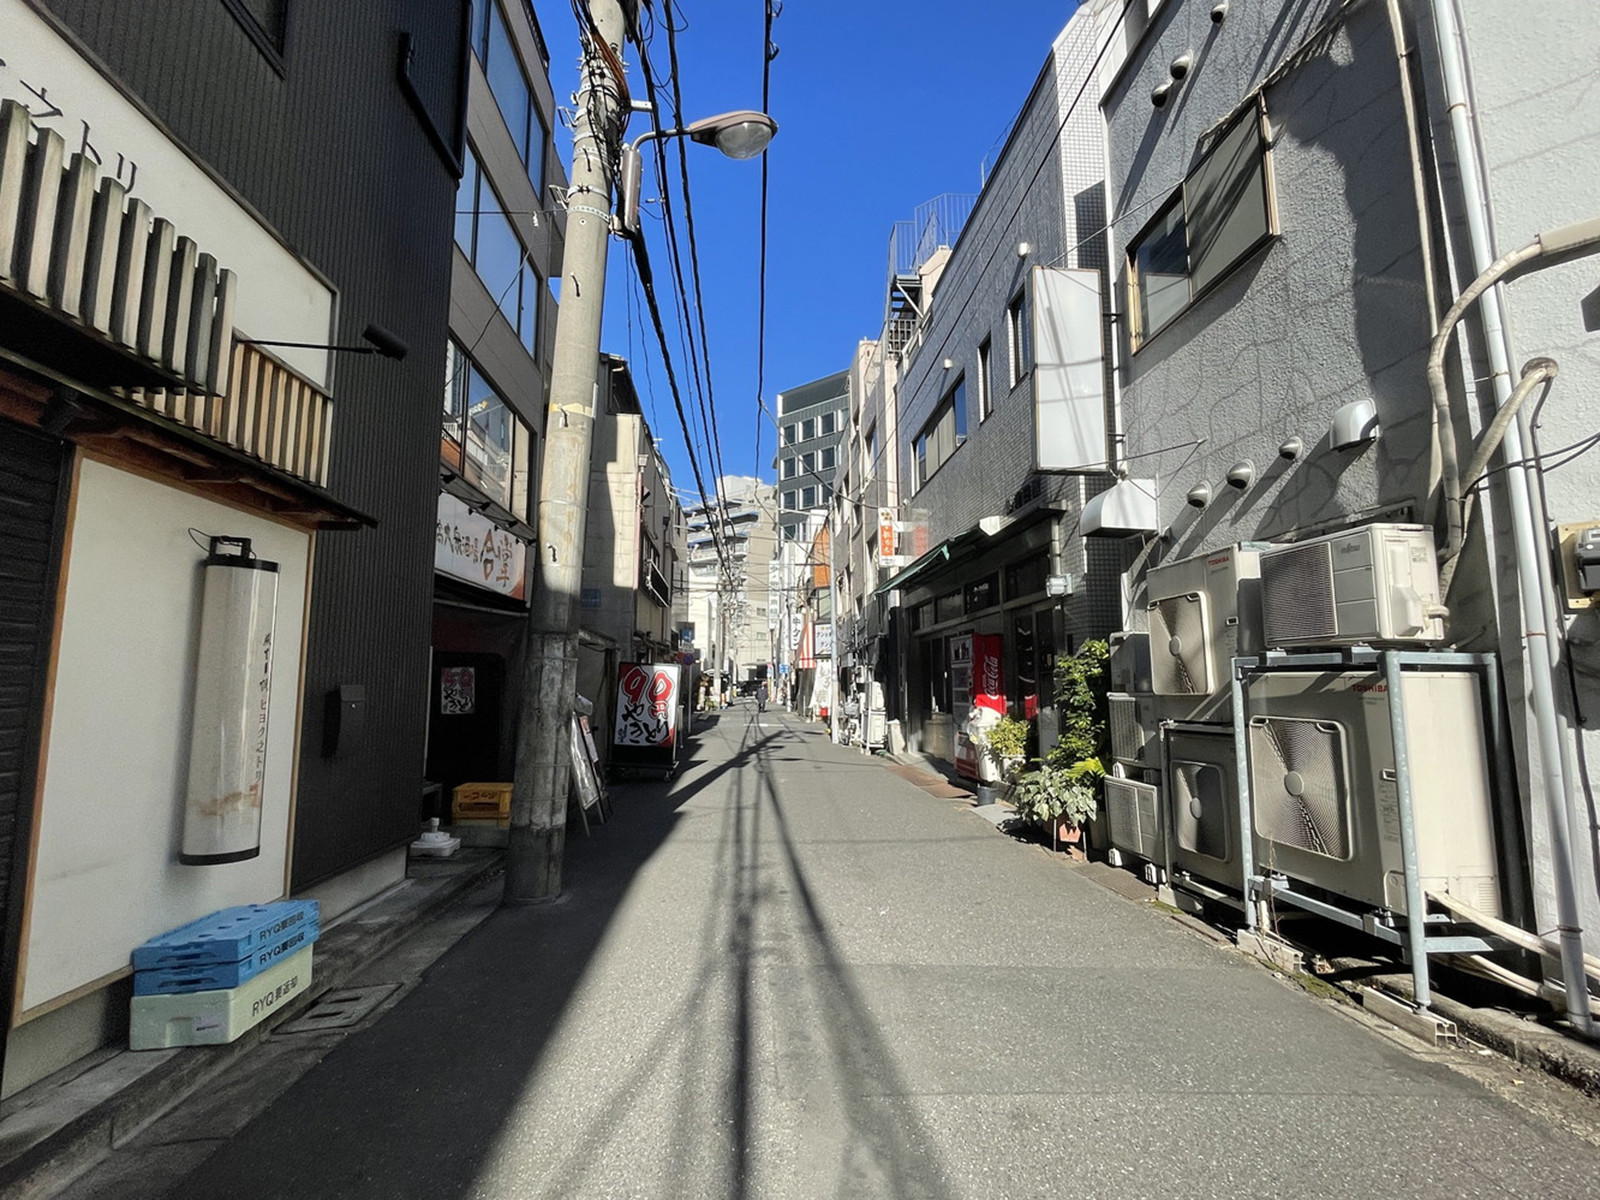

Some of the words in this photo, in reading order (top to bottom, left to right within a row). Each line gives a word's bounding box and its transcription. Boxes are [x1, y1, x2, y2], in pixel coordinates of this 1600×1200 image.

[1207, 555, 1230, 568] TOSHIBA
[984, 655, 1000, 700] Coca-Cola
[1351, 683, 1388, 693] TOSHIBA
[621, 703, 672, 744] やきとり
